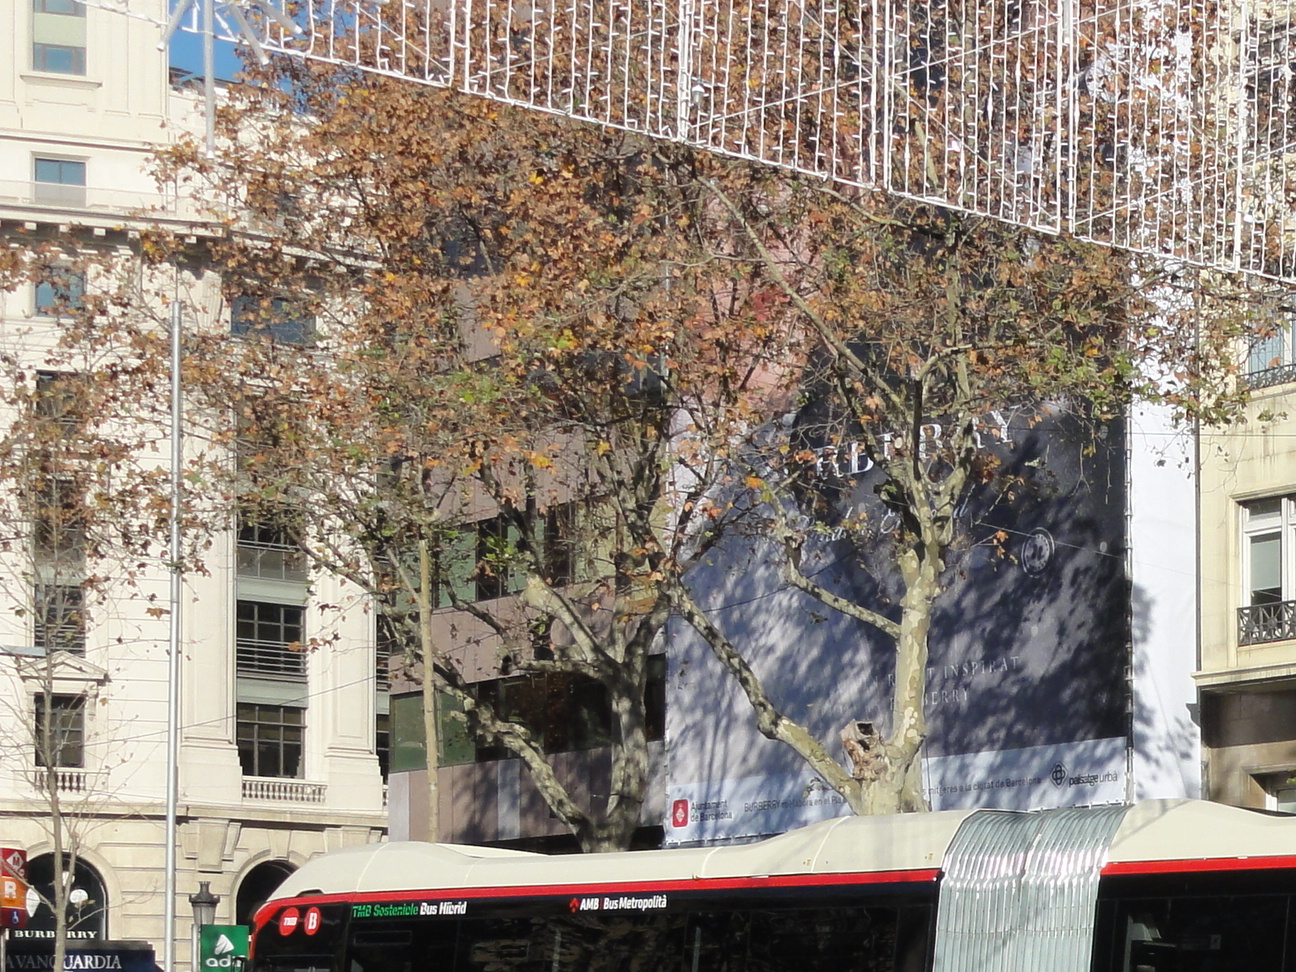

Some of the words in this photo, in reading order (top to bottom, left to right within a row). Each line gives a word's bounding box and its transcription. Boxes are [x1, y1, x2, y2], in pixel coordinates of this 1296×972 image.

[944, 656, 1019, 679] INSPIRAT
[1005, 777, 1042, 787] Barcelona
[1069, 774, 1098, 787] paisatge
[1099, 773, 1118, 783] urbà
[691, 799, 728, 813] Ajuntament
[744, 800, 780, 812] BURBERRY
[691, 813, 699, 822] de
[700, 811, 732, 821] Barcelona
[4, 881, 17, 899] R
[420, 902, 437, 915] Bus
[579, 898, 599, 911] AMB
[603, 897, 618, 910] Bus
[619, 894, 667, 912] Metropolità
[307, 912, 318, 930] B
[14, 930, 98, 939] BURBRRY
